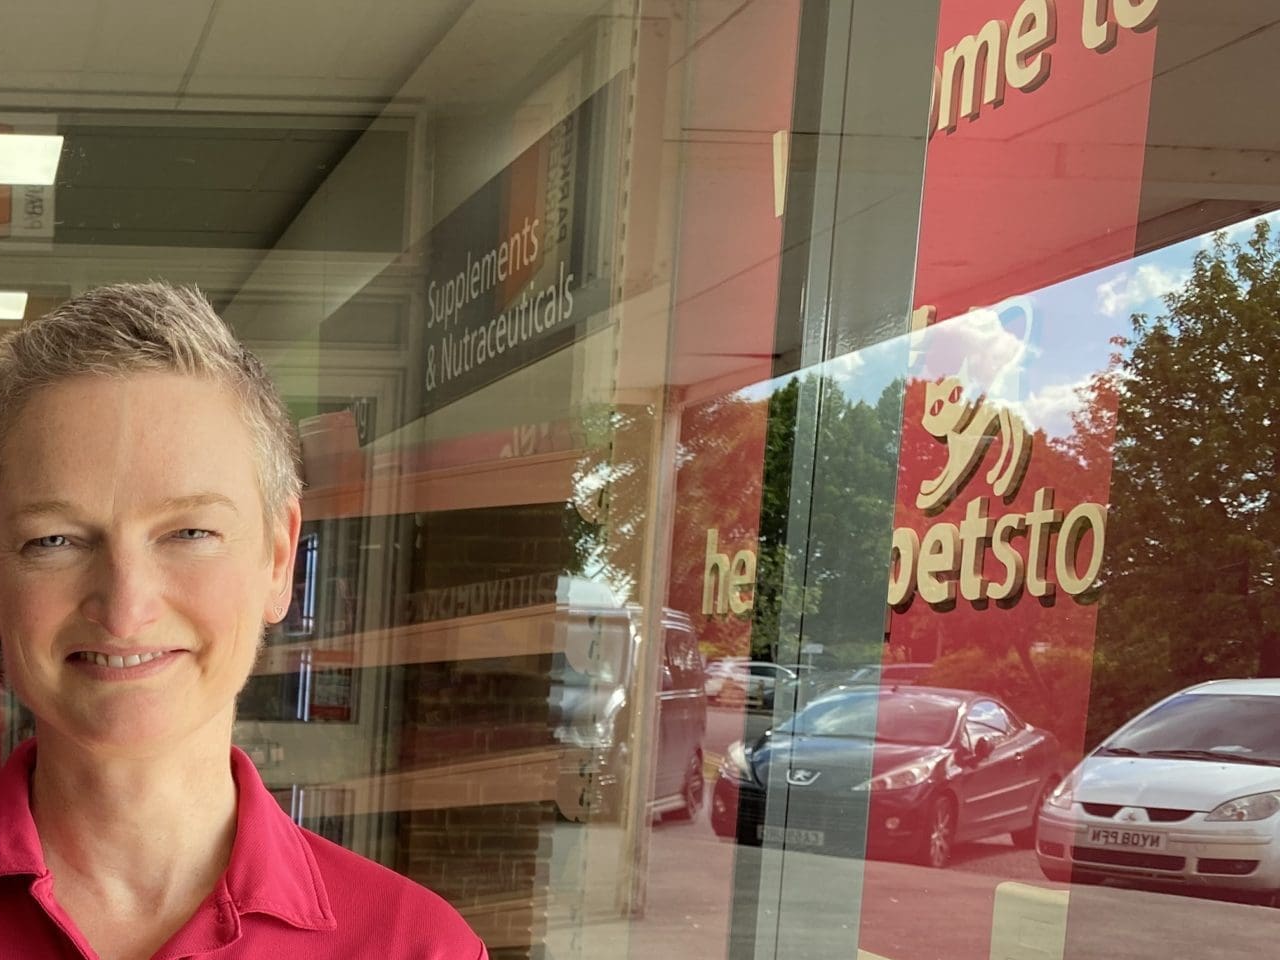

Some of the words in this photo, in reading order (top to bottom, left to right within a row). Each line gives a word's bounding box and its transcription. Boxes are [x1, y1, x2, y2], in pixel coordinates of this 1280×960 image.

[932, 0, 1057, 136] me
[425, 344, 436, 391] &
[440, 261, 574, 384] Nutraceuticals
[426, 216, 539, 330] Supplements
